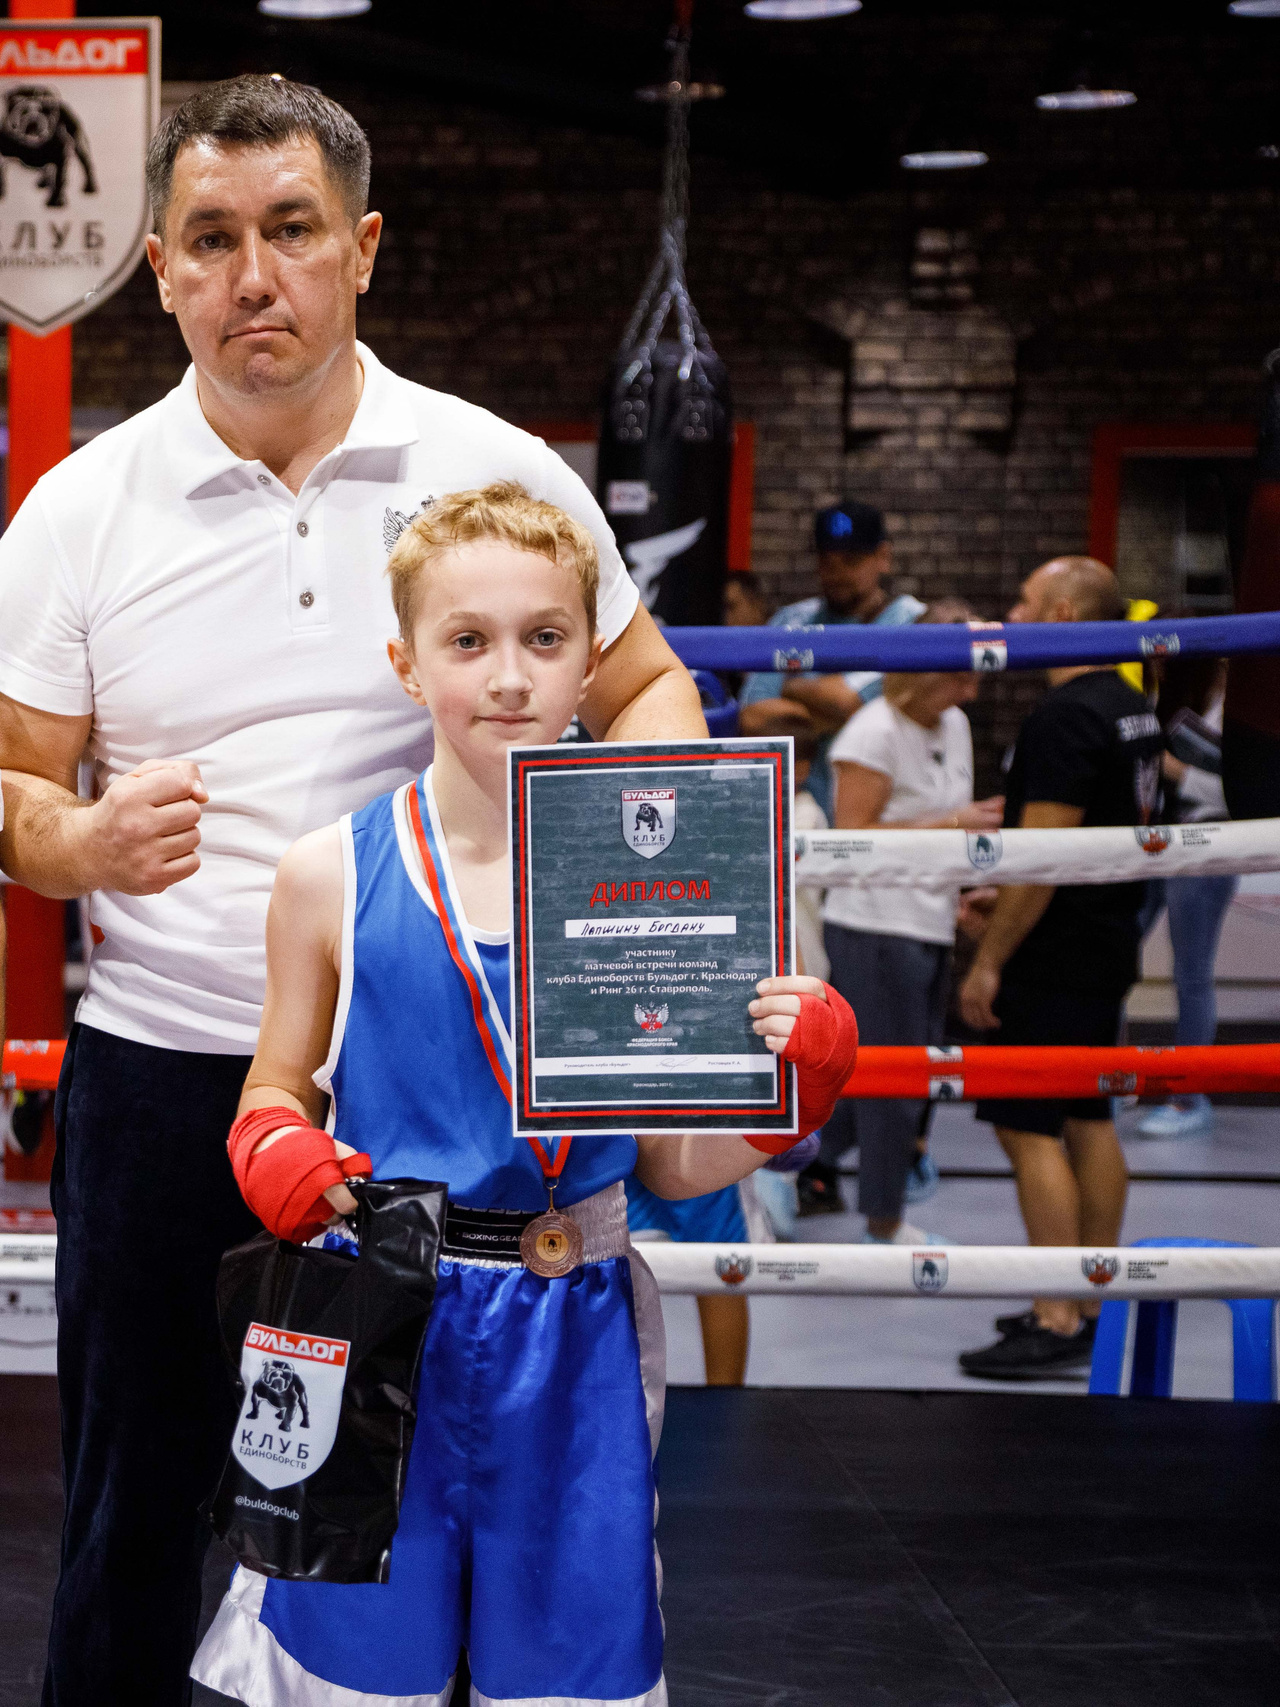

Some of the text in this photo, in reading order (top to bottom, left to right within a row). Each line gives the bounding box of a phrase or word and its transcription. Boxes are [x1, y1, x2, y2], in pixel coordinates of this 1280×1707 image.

[624, 791, 673, 800] БУЛЬДОГ
[633, 834, 665, 843] КЛУБ
[589, 880, 711, 908] ДИПЛОМ
[625, 949, 677, 959] участнику
[584, 960, 718, 971] матчевой встречи команд
[546, 974, 576, 986] клуба
[578, 973, 645, 984] Единоборств
[647, 972, 689, 983] Бульдог
[701, 971, 758, 982] Краснодар
[599, 985, 622, 994] Ринг
[625, 985, 637, 994] 26
[649, 984, 713, 995] Ставрополь.
[462, 1231, 498, 1242] BOXING
[247, 1328, 345, 1361] БУЛЬДОГ
[241, 1429, 310, 1460] КЛУБ
[239, 1446, 308, 1470] ЕДИНОБОРСТВ
[235, 1495, 300, 1521] @buldogclub
